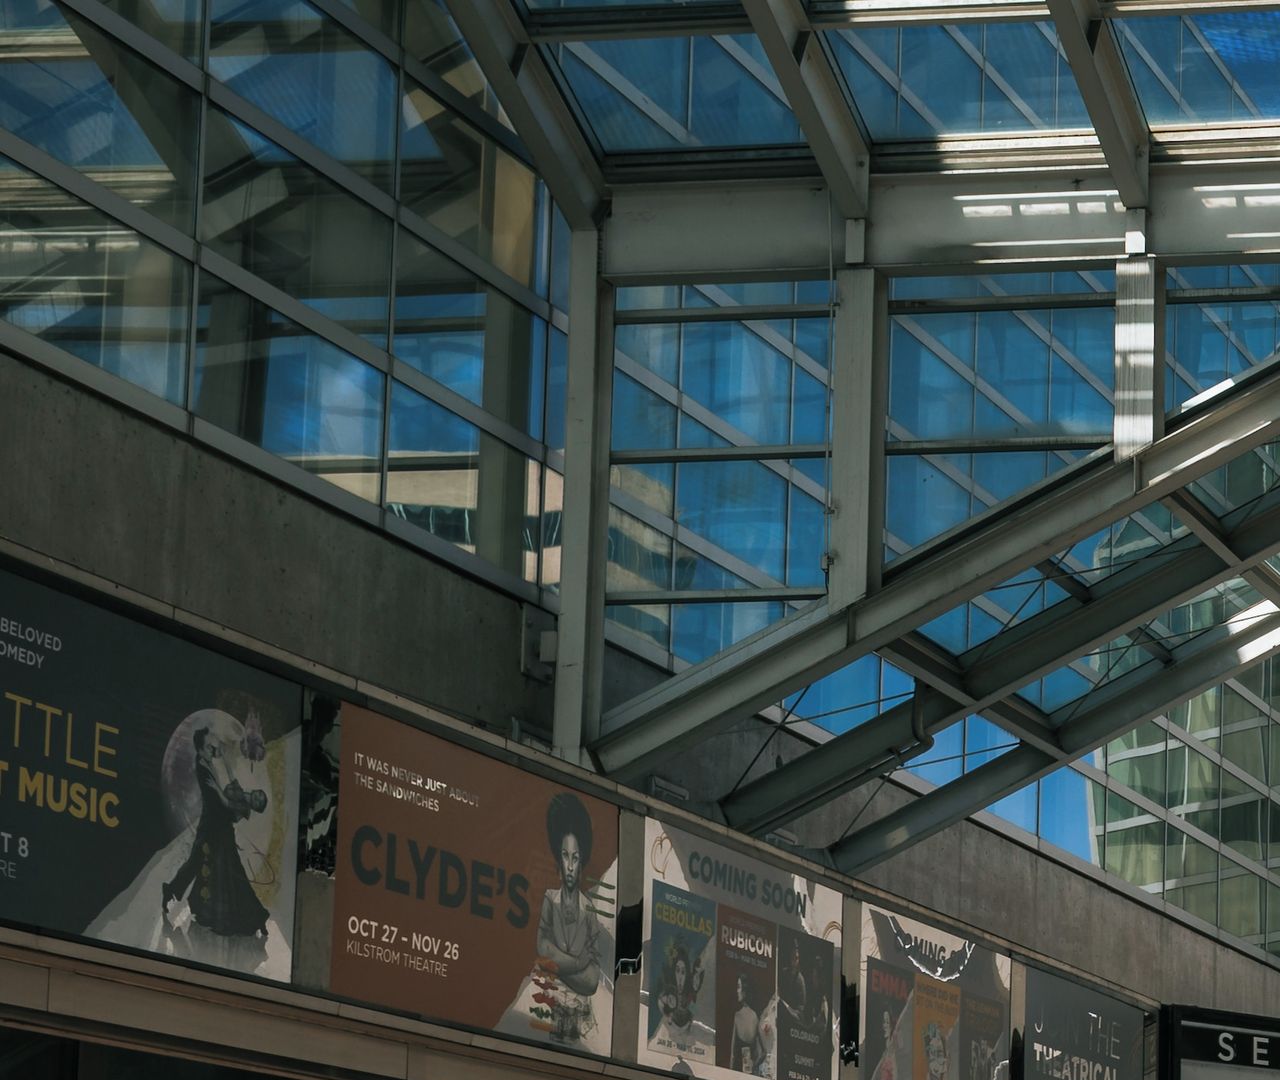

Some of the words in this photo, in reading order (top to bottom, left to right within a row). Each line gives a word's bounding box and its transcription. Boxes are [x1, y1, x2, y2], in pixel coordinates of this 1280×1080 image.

[1, 616, 62, 651] BELOVED
[4, 691, 120, 779] TTLE
[18, 766, 120, 828] MUSIC
[354, 752, 364, 765] IT
[366, 756, 389, 775] WAS
[391, 766, 423, 788] NEVER
[424, 777, 447, 796] JUST
[449, 787, 480, 808] ABOUT
[354, 772, 374, 790] THE
[376, 779, 440, 812] SANDWICHES
[18, 837, 29, 858] 8
[351, 825, 531, 929] CLYDE'S
[688, 851, 757, 902] COMING
[761, 879, 806, 918] SOON
[348, 916, 378, 938] OCT
[381, 924, 398, 944] 27
[412, 932, 441, 955] NOV
[444, 941, 459, 960] 26
[655, 903, 714, 937] CEBOLLAS
[721, 925, 773, 959] RUBICON
[346, 939, 400, 965] KILSTROM
[403, 953, 448, 978] THEATRE
[1087, 1012, 1121, 1060] THE
